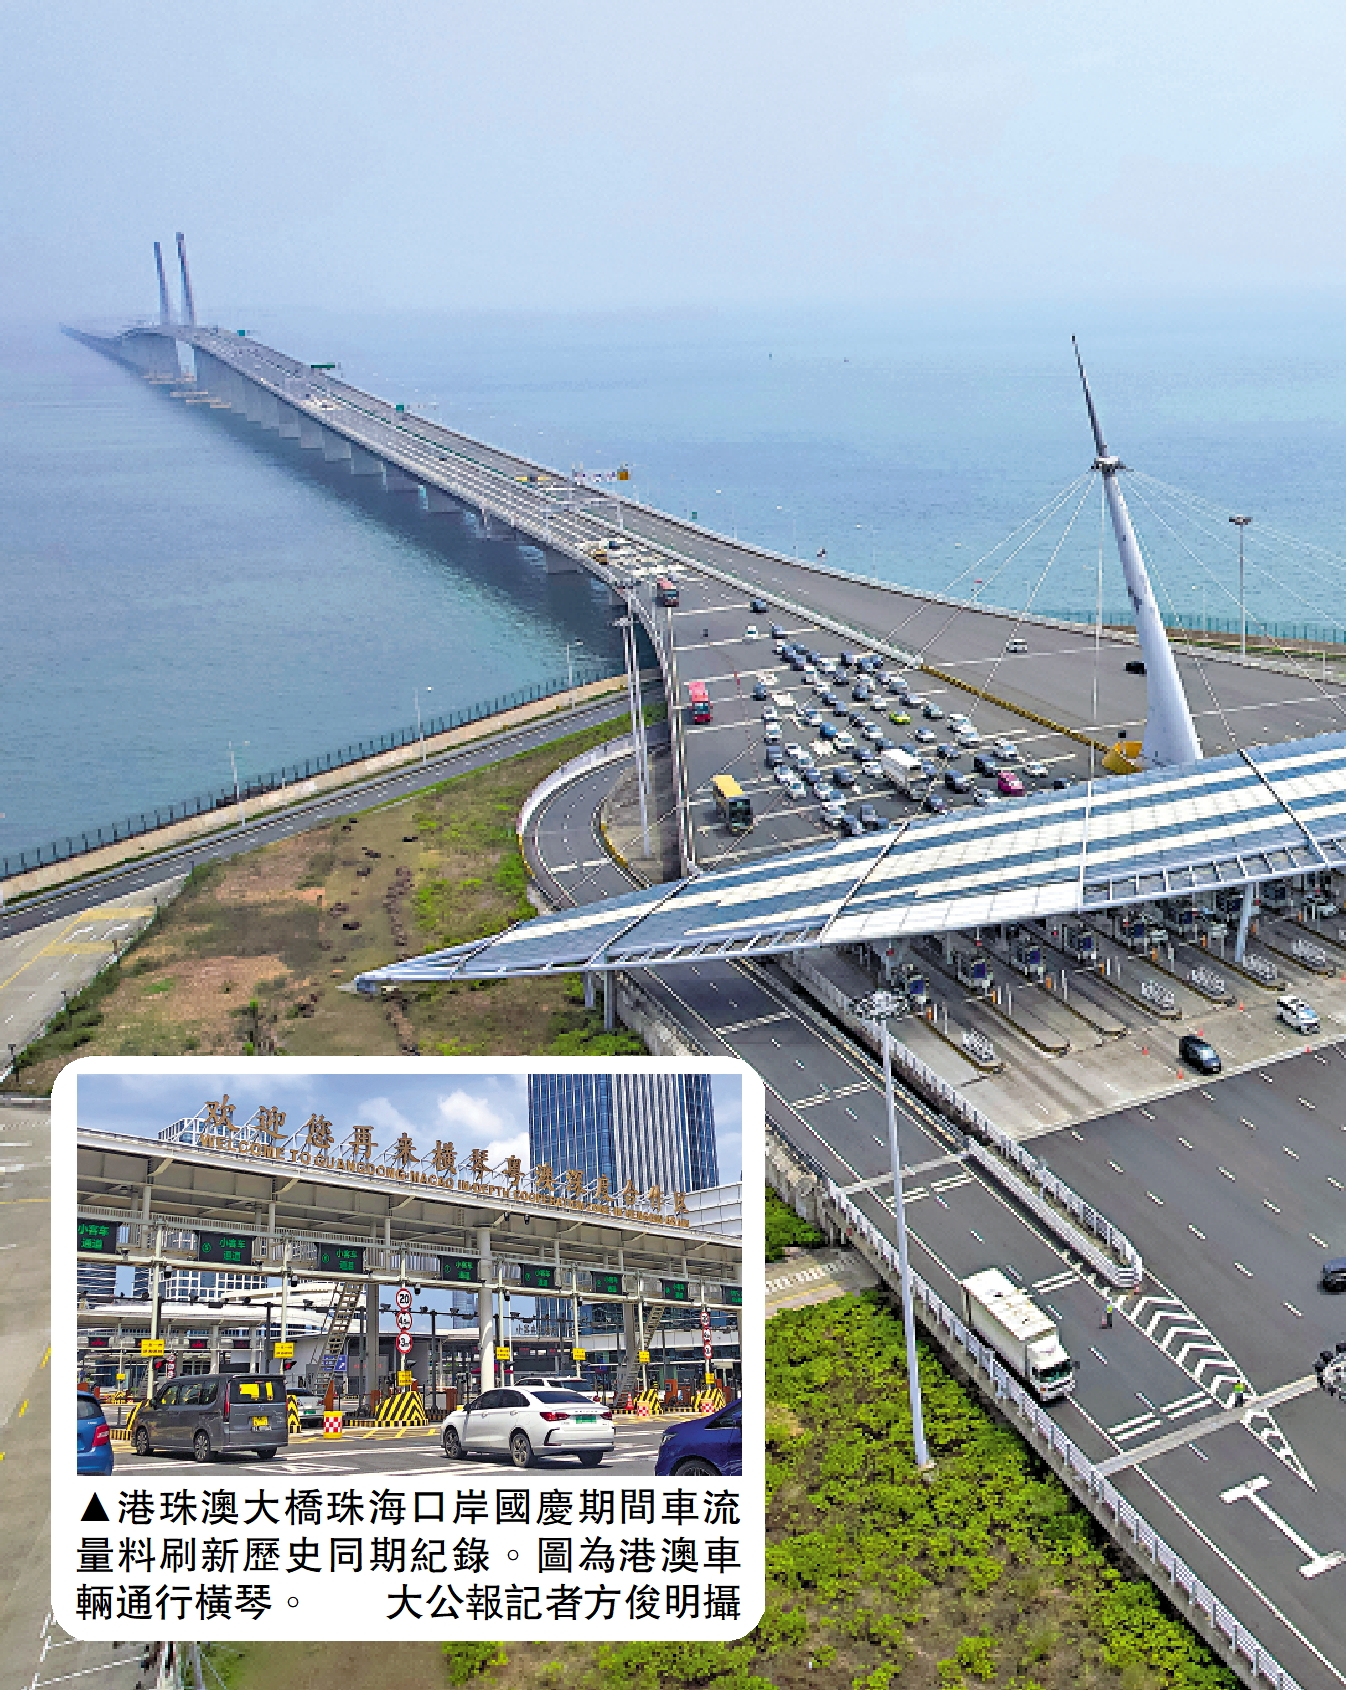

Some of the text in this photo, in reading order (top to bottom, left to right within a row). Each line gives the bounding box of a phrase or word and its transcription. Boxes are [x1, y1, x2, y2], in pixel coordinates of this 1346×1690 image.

[199, 1134, 286, 1161] WELCOME
[290, 1149, 312, 1165] TO
[78, 1225, 109, 1237] 小客车
[81, 1238, 103, 1250] 通道
[219, 1238, 246, 1249] 小客车
[400, 1294, 410, 1304] 20
